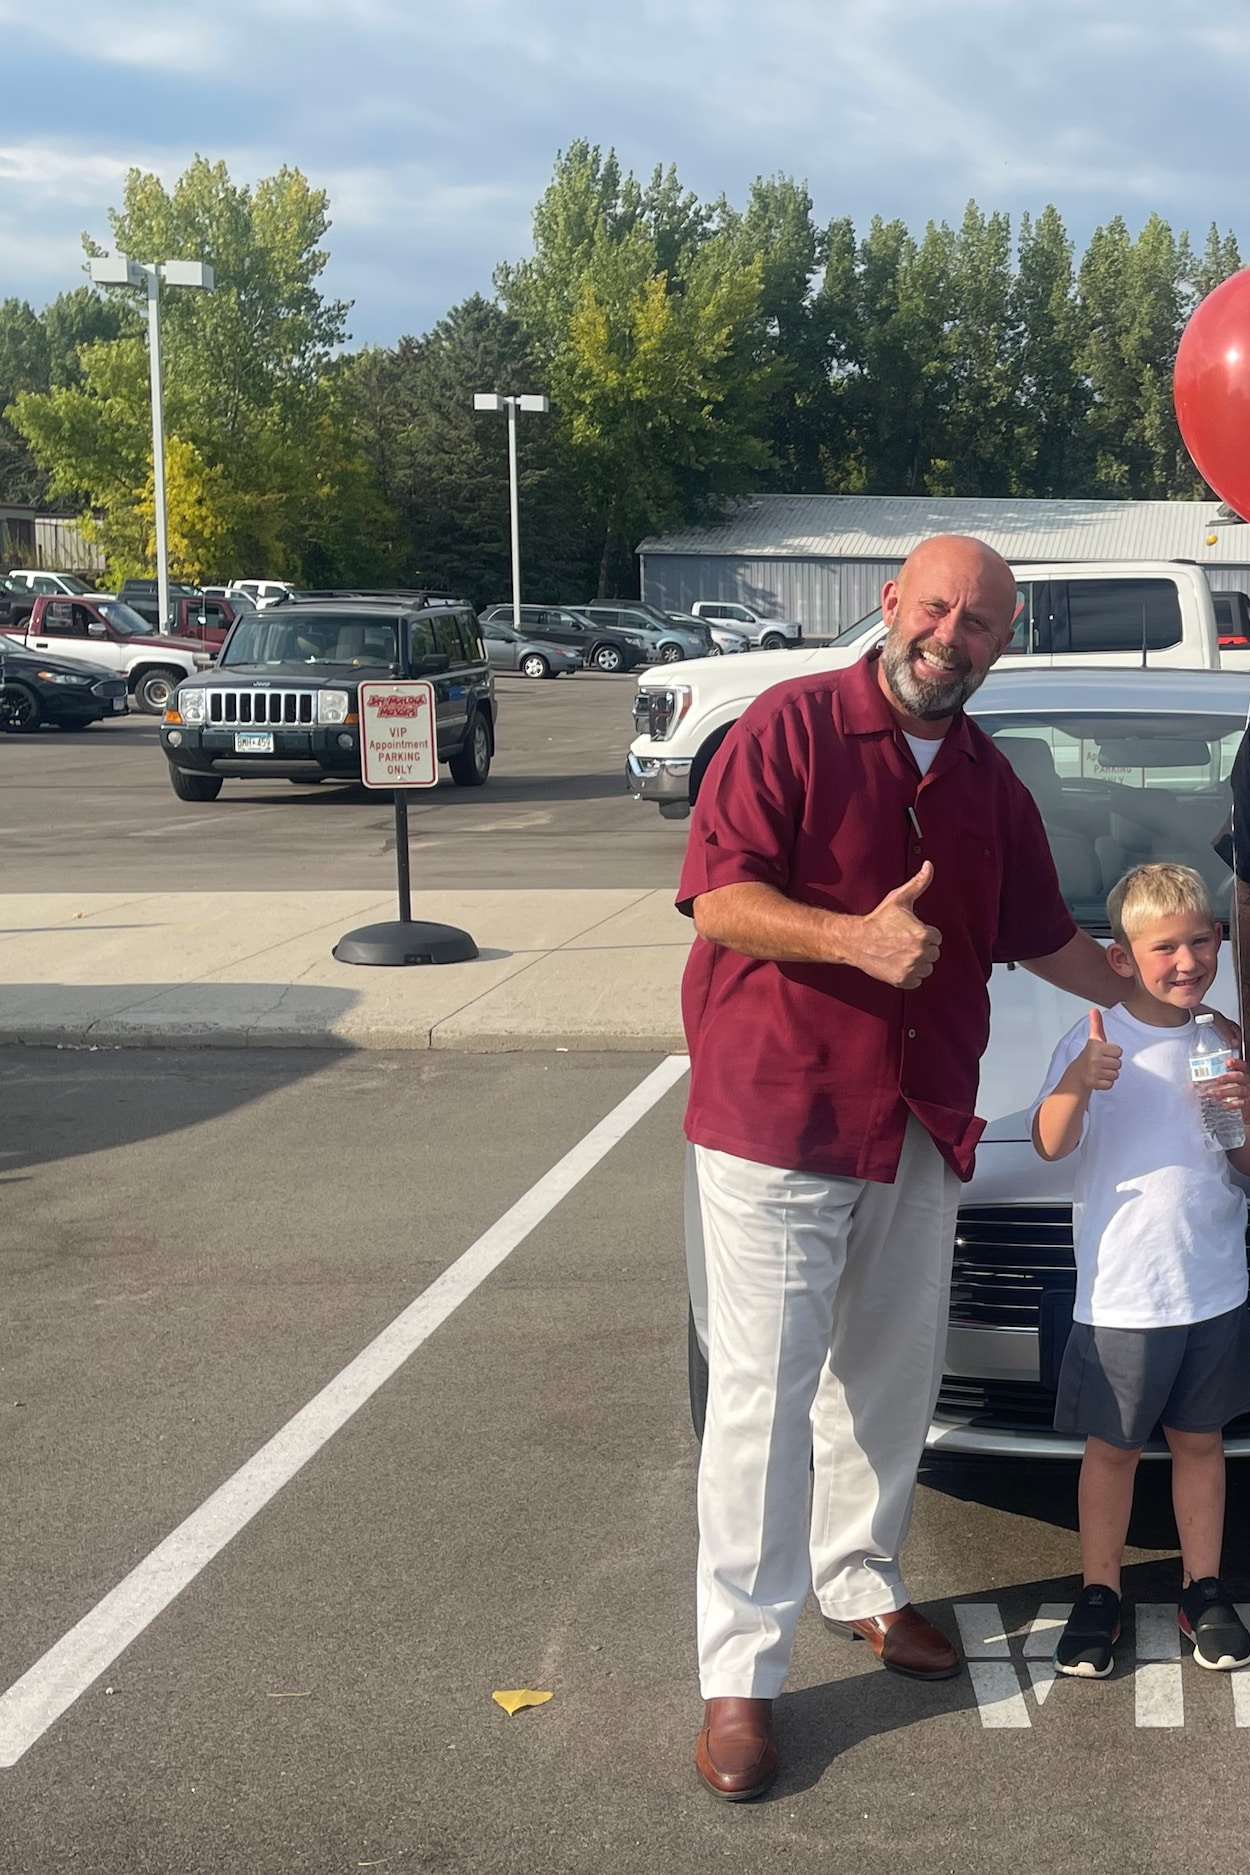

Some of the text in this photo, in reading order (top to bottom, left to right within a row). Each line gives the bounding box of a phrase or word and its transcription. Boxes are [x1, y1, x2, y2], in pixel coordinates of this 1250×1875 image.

[389, 727, 407, 738] VIP
[369, 740, 429, 751] Appointment
[378, 752, 420, 762] PARKING
[387, 764, 413, 775] ONLY
